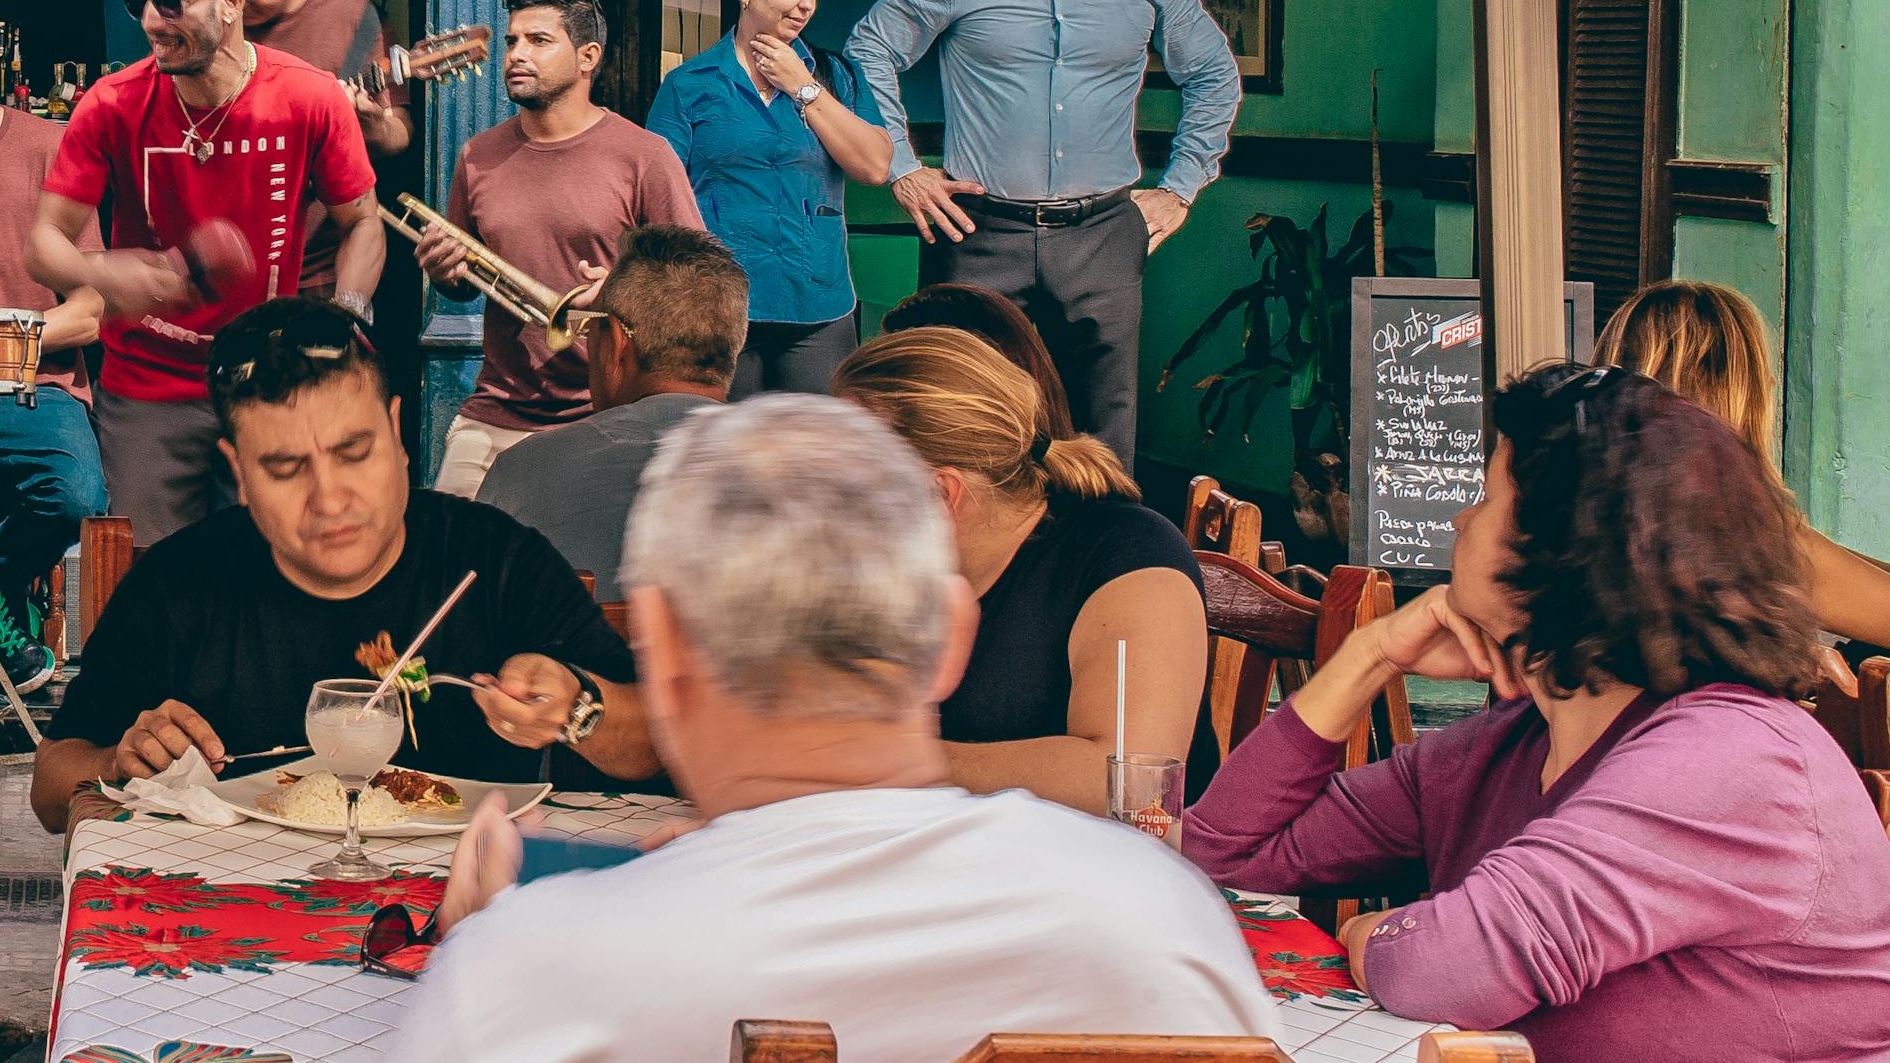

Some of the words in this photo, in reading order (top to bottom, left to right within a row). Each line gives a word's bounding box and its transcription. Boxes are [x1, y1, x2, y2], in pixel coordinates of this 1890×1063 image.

[188, 136, 286, 157] LONDON
[270, 163, 286, 201] NEW
[268, 214, 287, 261] YORK
[1441, 318, 1482, 346] CRIST
[1379, 550, 1434, 567] CUC
[1130, 809, 1172, 824] Havana
[1139, 824, 1164, 837] Club
